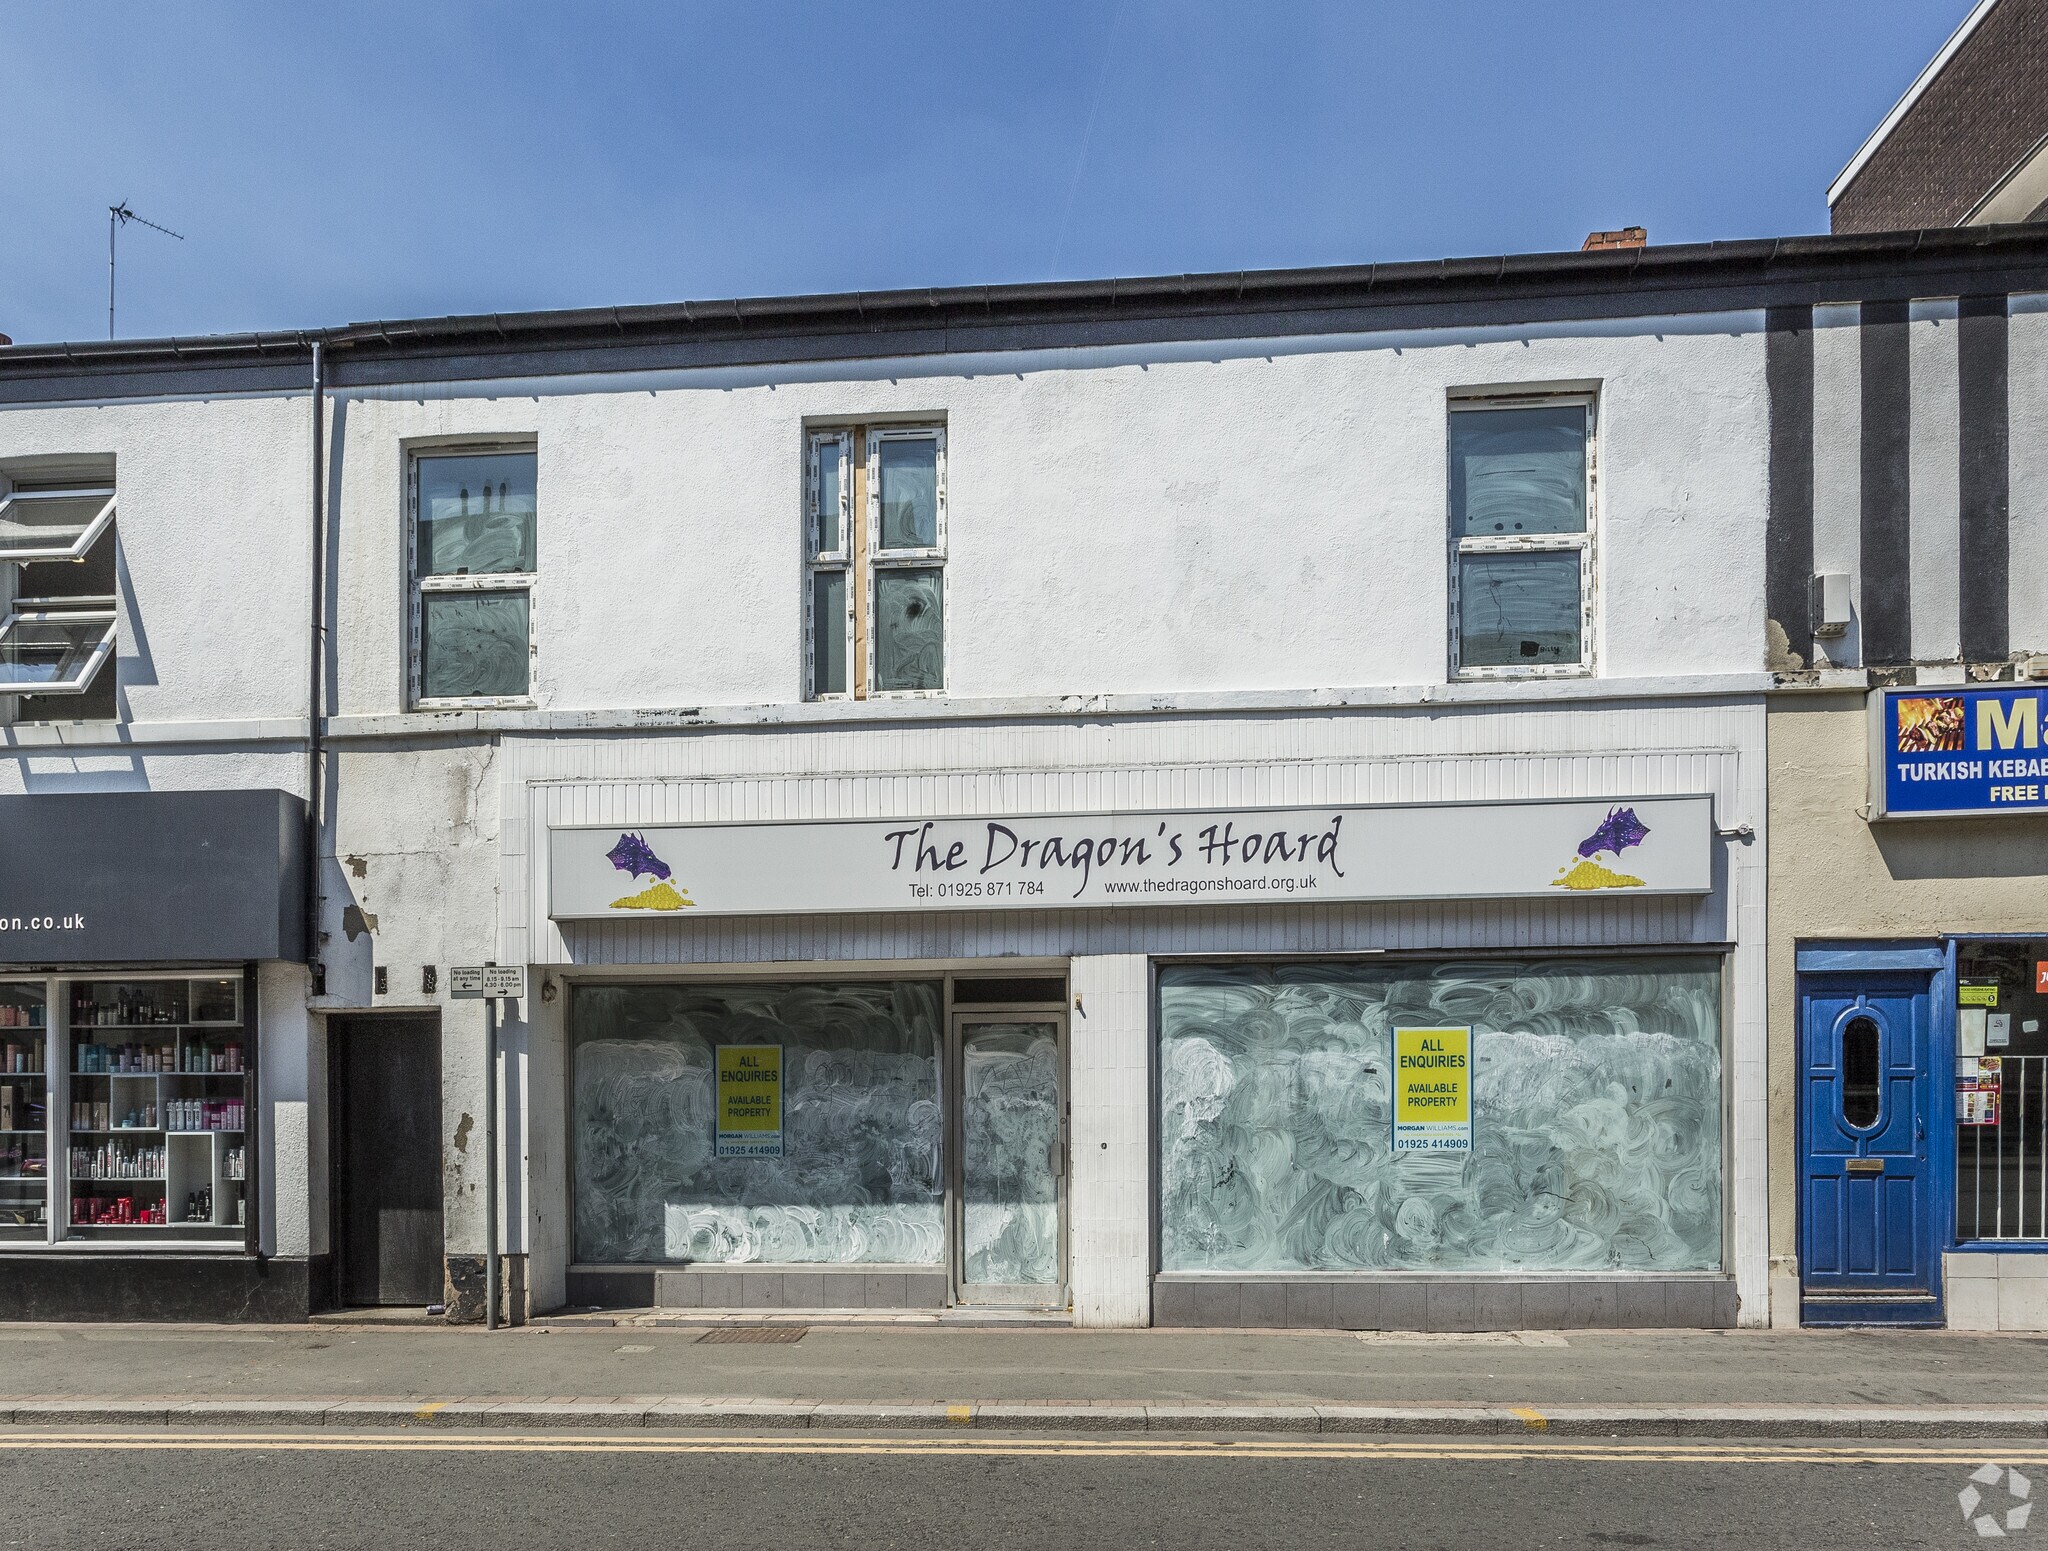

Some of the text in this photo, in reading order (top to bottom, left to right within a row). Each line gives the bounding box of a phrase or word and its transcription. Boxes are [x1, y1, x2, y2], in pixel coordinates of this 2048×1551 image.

[1977, 697, 2048, 751] M
[1898, 761, 1982, 781] TURKISH
[1990, 785, 2039, 802] FREE
[885, 815, 1344, 898] The Dragon's Hoard
[908, 876, 1318, 897] Tel: 01925 871 784 www.thedragonshoard.org.uk
[1420, 1039, 1445, 1051] ALL
[739, 1055, 759, 1067] ALL
[1400, 1055, 1466, 1068] ENQUIRIES
[721, 1071, 778, 1082] ENQUIRIES
[1407, 1083, 1458, 1093] AVAILABLE
[727, 1095, 771, 1105] AVAILABLE
[1407, 1097, 1458, 1107] PROPERTY
[727, 1107, 771, 1117] PROPERTY
[1398, 1139, 1468, 1148] 01925 414909
[719, 1146, 780, 1155] 01925 414909
